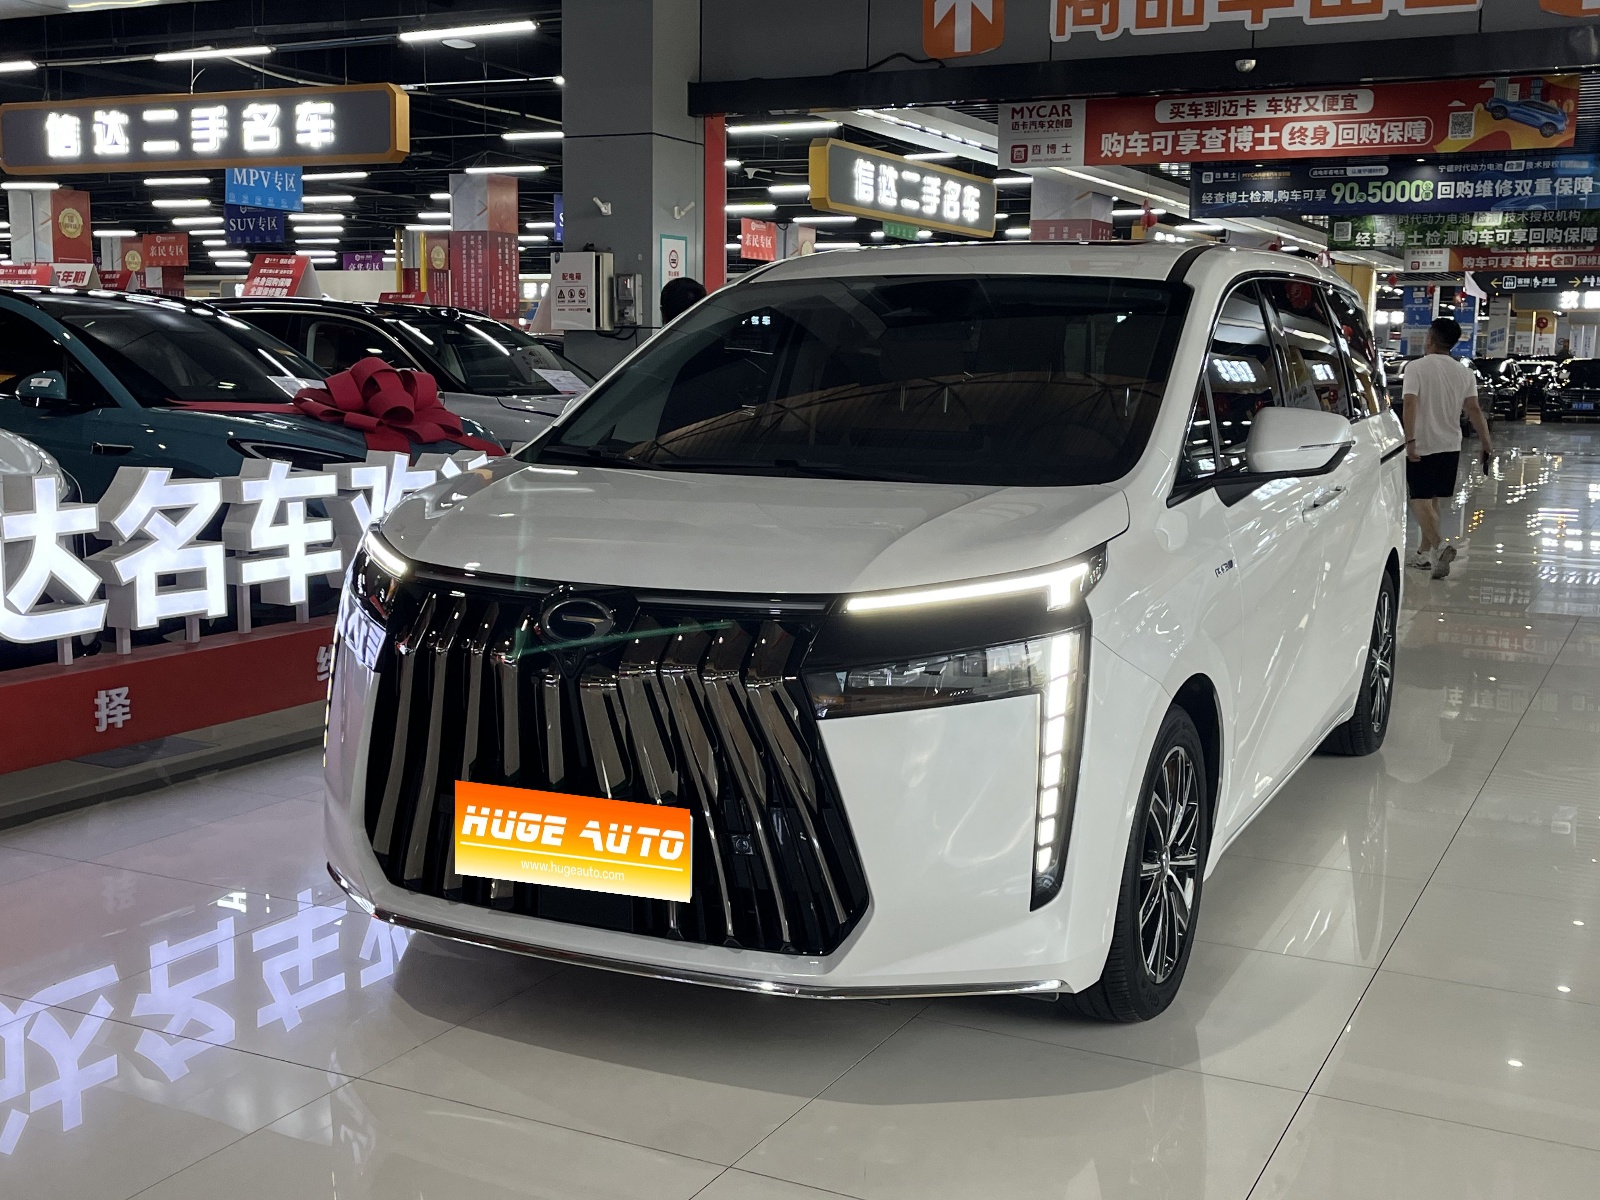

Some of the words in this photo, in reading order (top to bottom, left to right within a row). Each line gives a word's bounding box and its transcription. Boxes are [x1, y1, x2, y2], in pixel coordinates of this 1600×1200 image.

[1011, 103, 1072, 120] MYCAR
[1169, 98, 1257, 120] 买车到迈卡
[1266, 93, 1358, 115] 车好又便宜
[45, 101, 335, 158] 信达二手名车
[233, 167, 297, 192] MPV专区
[853, 157, 981, 223] 信达二手名车
[229, 216, 278, 232] SUV专区
[562, 272, 582, 281] 配电箱
[94, 686, 132, 733] 择
